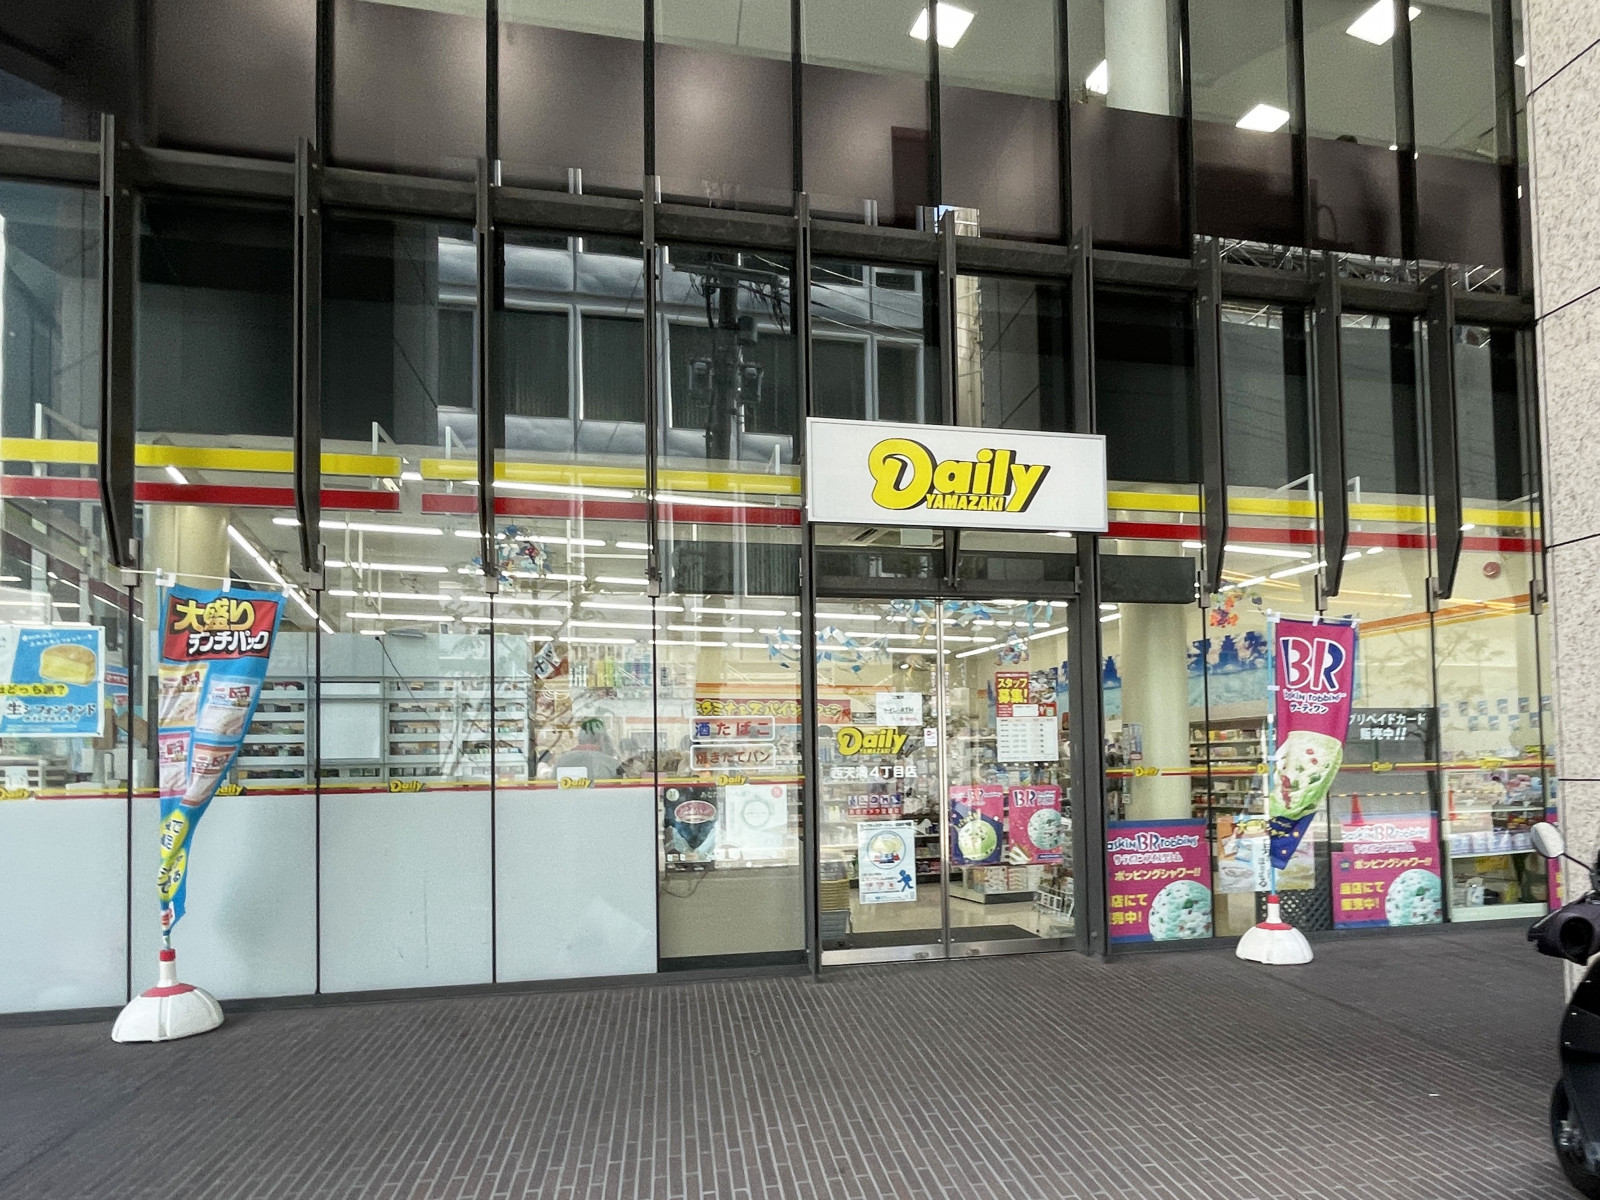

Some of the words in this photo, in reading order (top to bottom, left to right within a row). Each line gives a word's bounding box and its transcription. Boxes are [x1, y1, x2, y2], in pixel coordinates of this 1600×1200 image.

[868, 438, 1050, 512] Daily
[926, 494, 1006, 511] YAMAZAKI
[174, 597, 255, 632] 大盛り
[188, 629, 270, 655] ランチパック
[1280, 637, 1346, 691] BR
[997, 678, 1028, 688] スタッフ
[837, 726, 908, 755] Daily
[696, 750, 770, 764] 焼きたてパン
[830, 765, 917, 779] 西天満4丁目店
[1013, 790, 1036, 806] BR
[1136, 832, 1160, 851] BR
